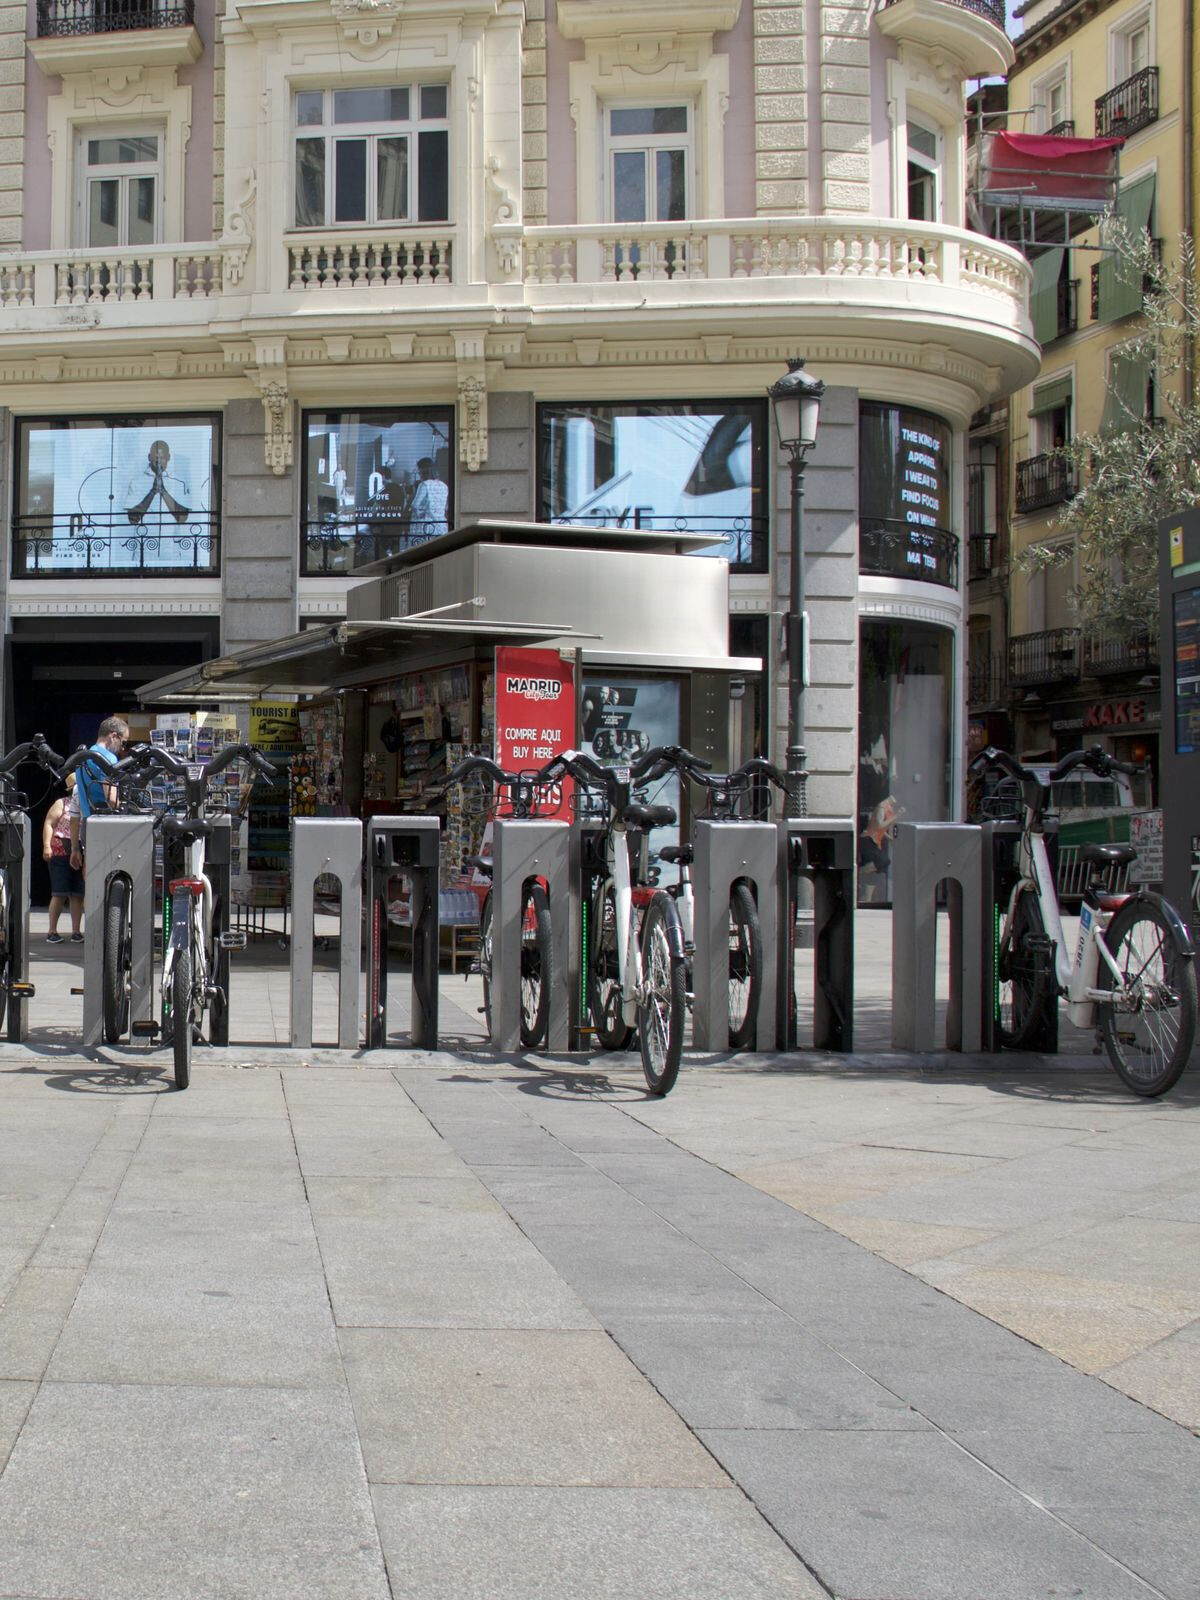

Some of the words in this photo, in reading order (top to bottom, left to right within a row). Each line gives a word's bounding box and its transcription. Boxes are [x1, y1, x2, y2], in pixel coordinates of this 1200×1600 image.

[902, 428, 918, 443] THE
[918, 432, 932, 448] KIND
[907, 450, 936, 470] APPAREL
[909, 470, 930, 487] WEAR
[901, 489, 921, 503] FIND
[921, 493, 939, 511] FOCUS
[906, 511, 920, 523] ON
[920, 513, 936, 528] WHAT
[507, 678, 562, 694] MADRID
[250, 707, 288, 718] TOURIST
[1086, 700, 1145, 727] KAKE
[505, 728, 537, 741] COMPRE
[541, 729, 561, 744] AQUI
[513, 746, 529, 758] BUY
[533, 746, 553, 759] HERE
[1076, 936, 1085, 969] 2820
